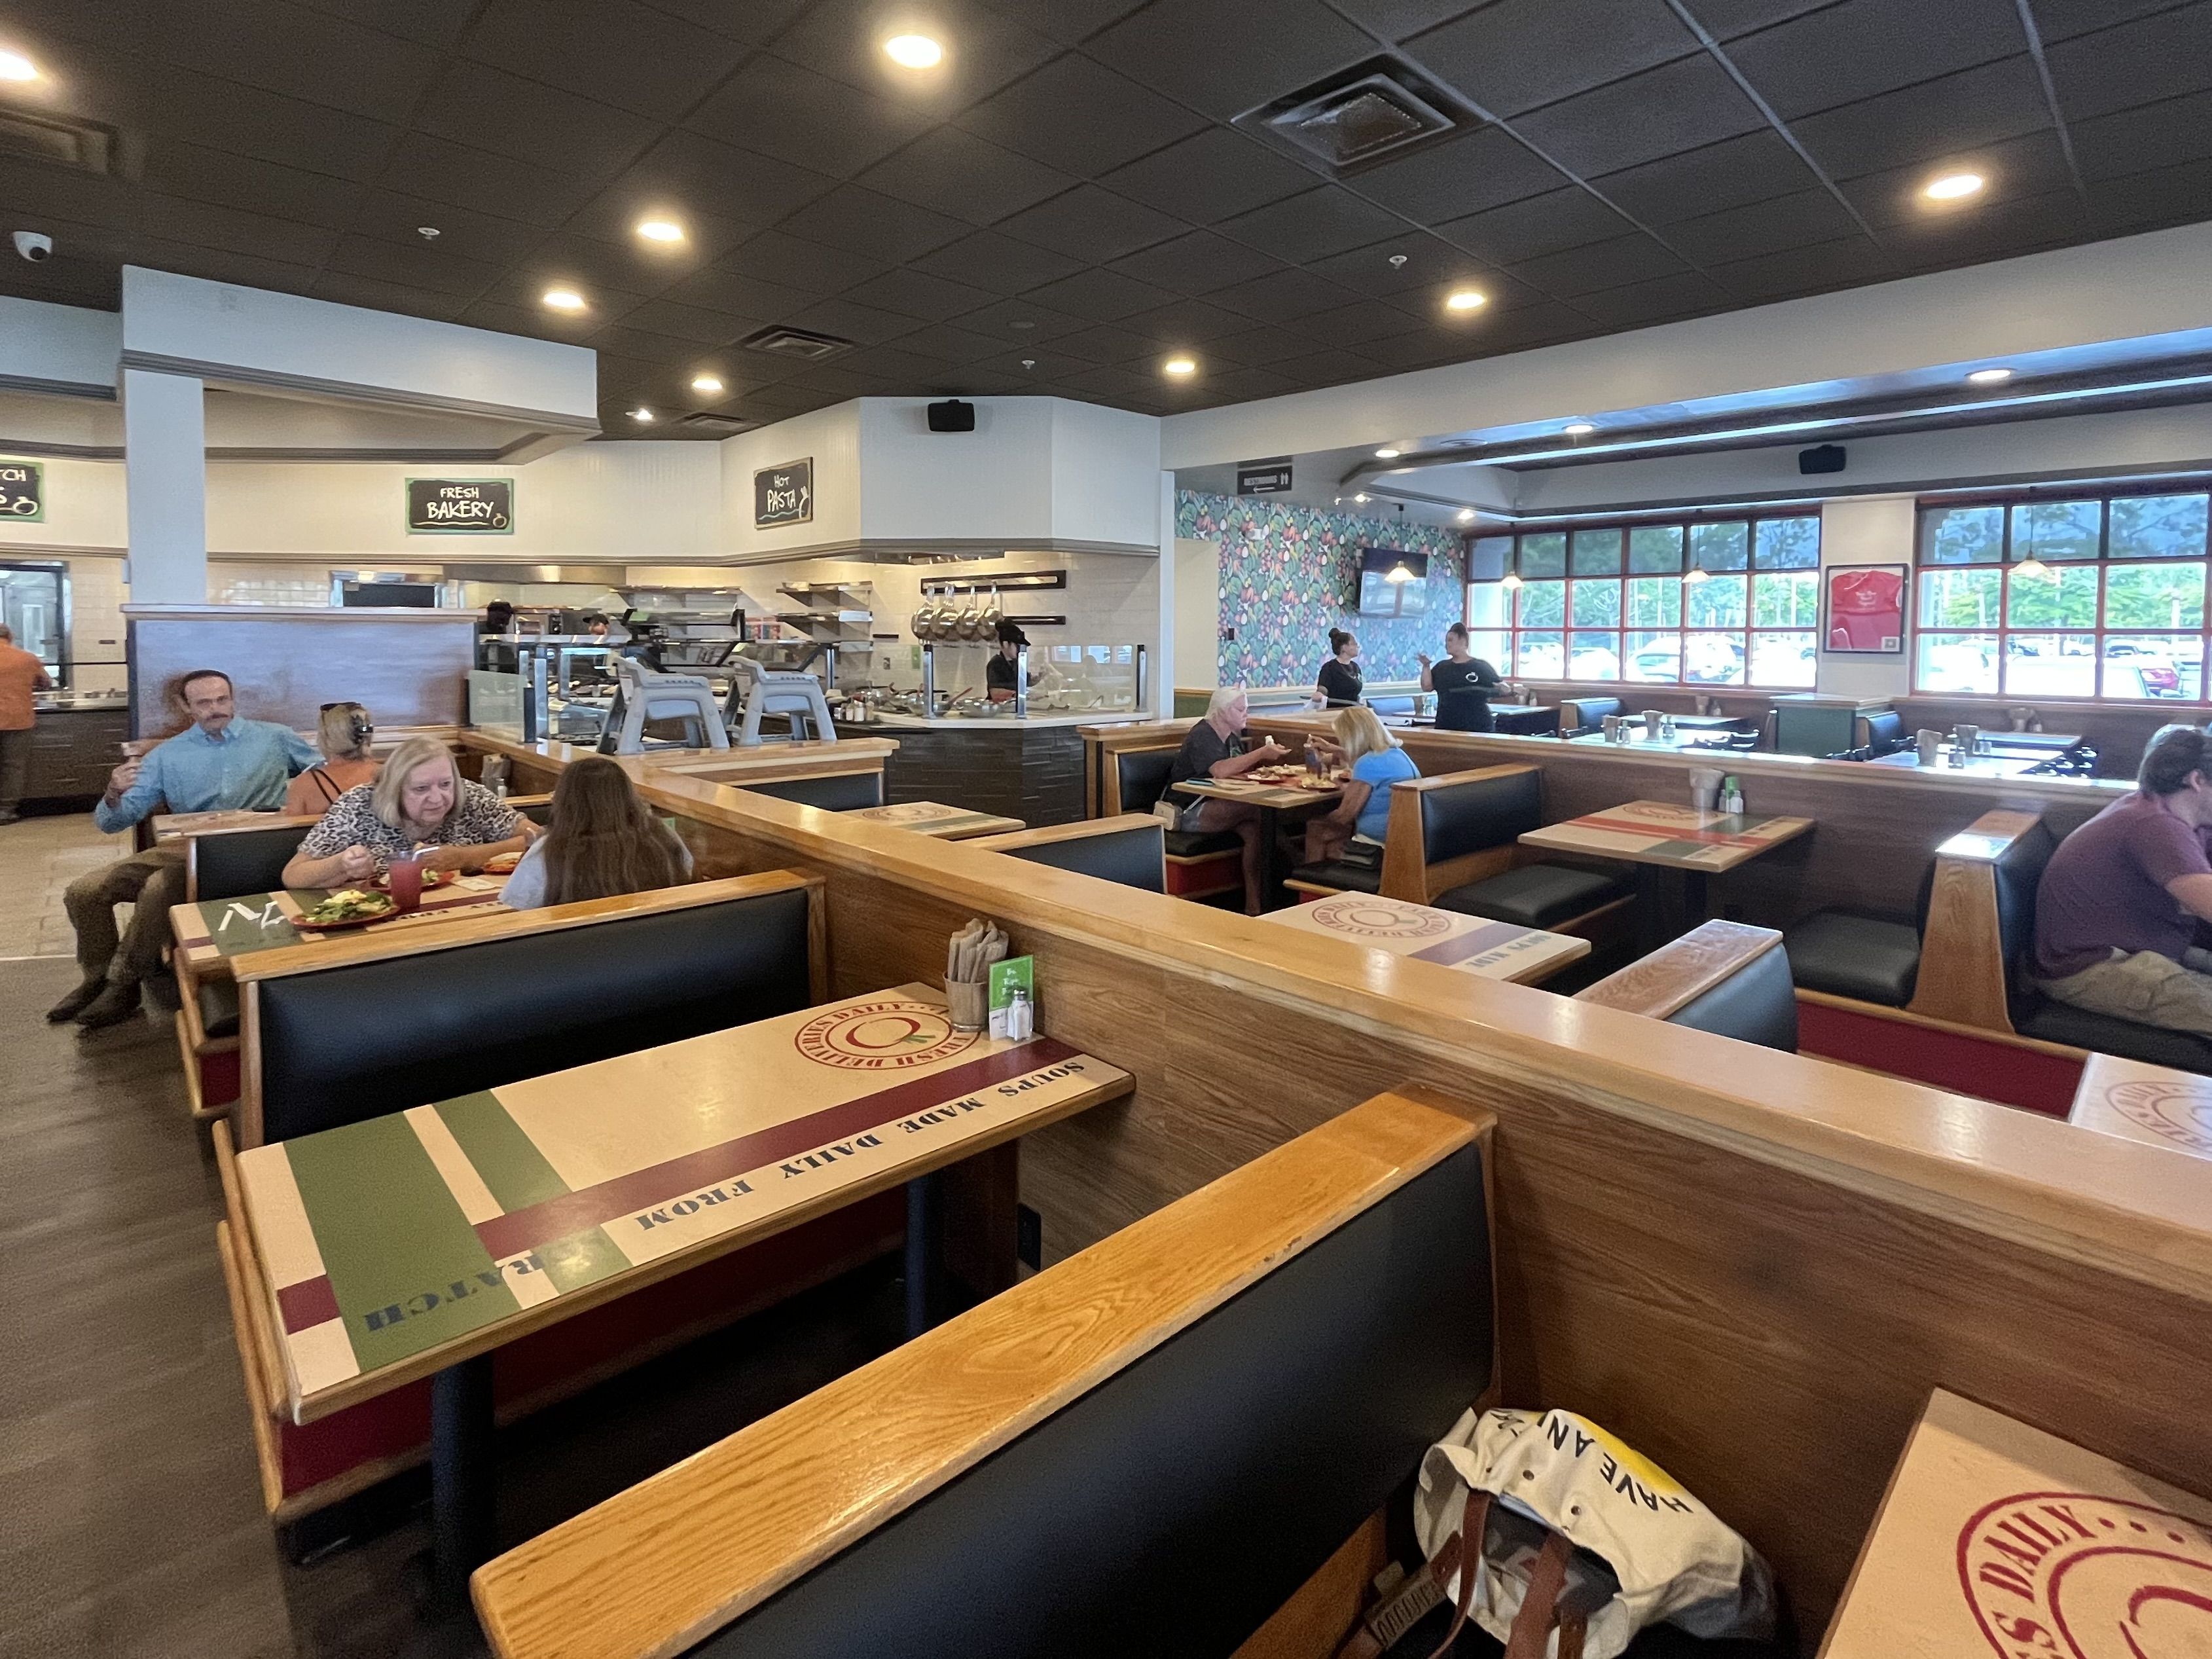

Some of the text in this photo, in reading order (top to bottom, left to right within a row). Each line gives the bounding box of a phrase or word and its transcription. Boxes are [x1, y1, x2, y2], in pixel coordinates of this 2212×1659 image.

[441, 486, 479, 499] FRESH
[774, 475, 790, 488] HOT
[427, 500, 494, 519] BAKERY
[767, 489, 795, 512] PASTA
[801, 1003, 971, 1068] FRESH DELIVERIES DAILY
[998, 1061, 1085, 1097] SOUPS
[896, 1097, 986, 1134] MADE
[778, 1133, 885, 1180] DAILY
[634, 1179, 755, 1231] FROM
[1599, 1451, 1694, 1514] HAVE
[1978, 1504, 2098, 1604] DAILY
